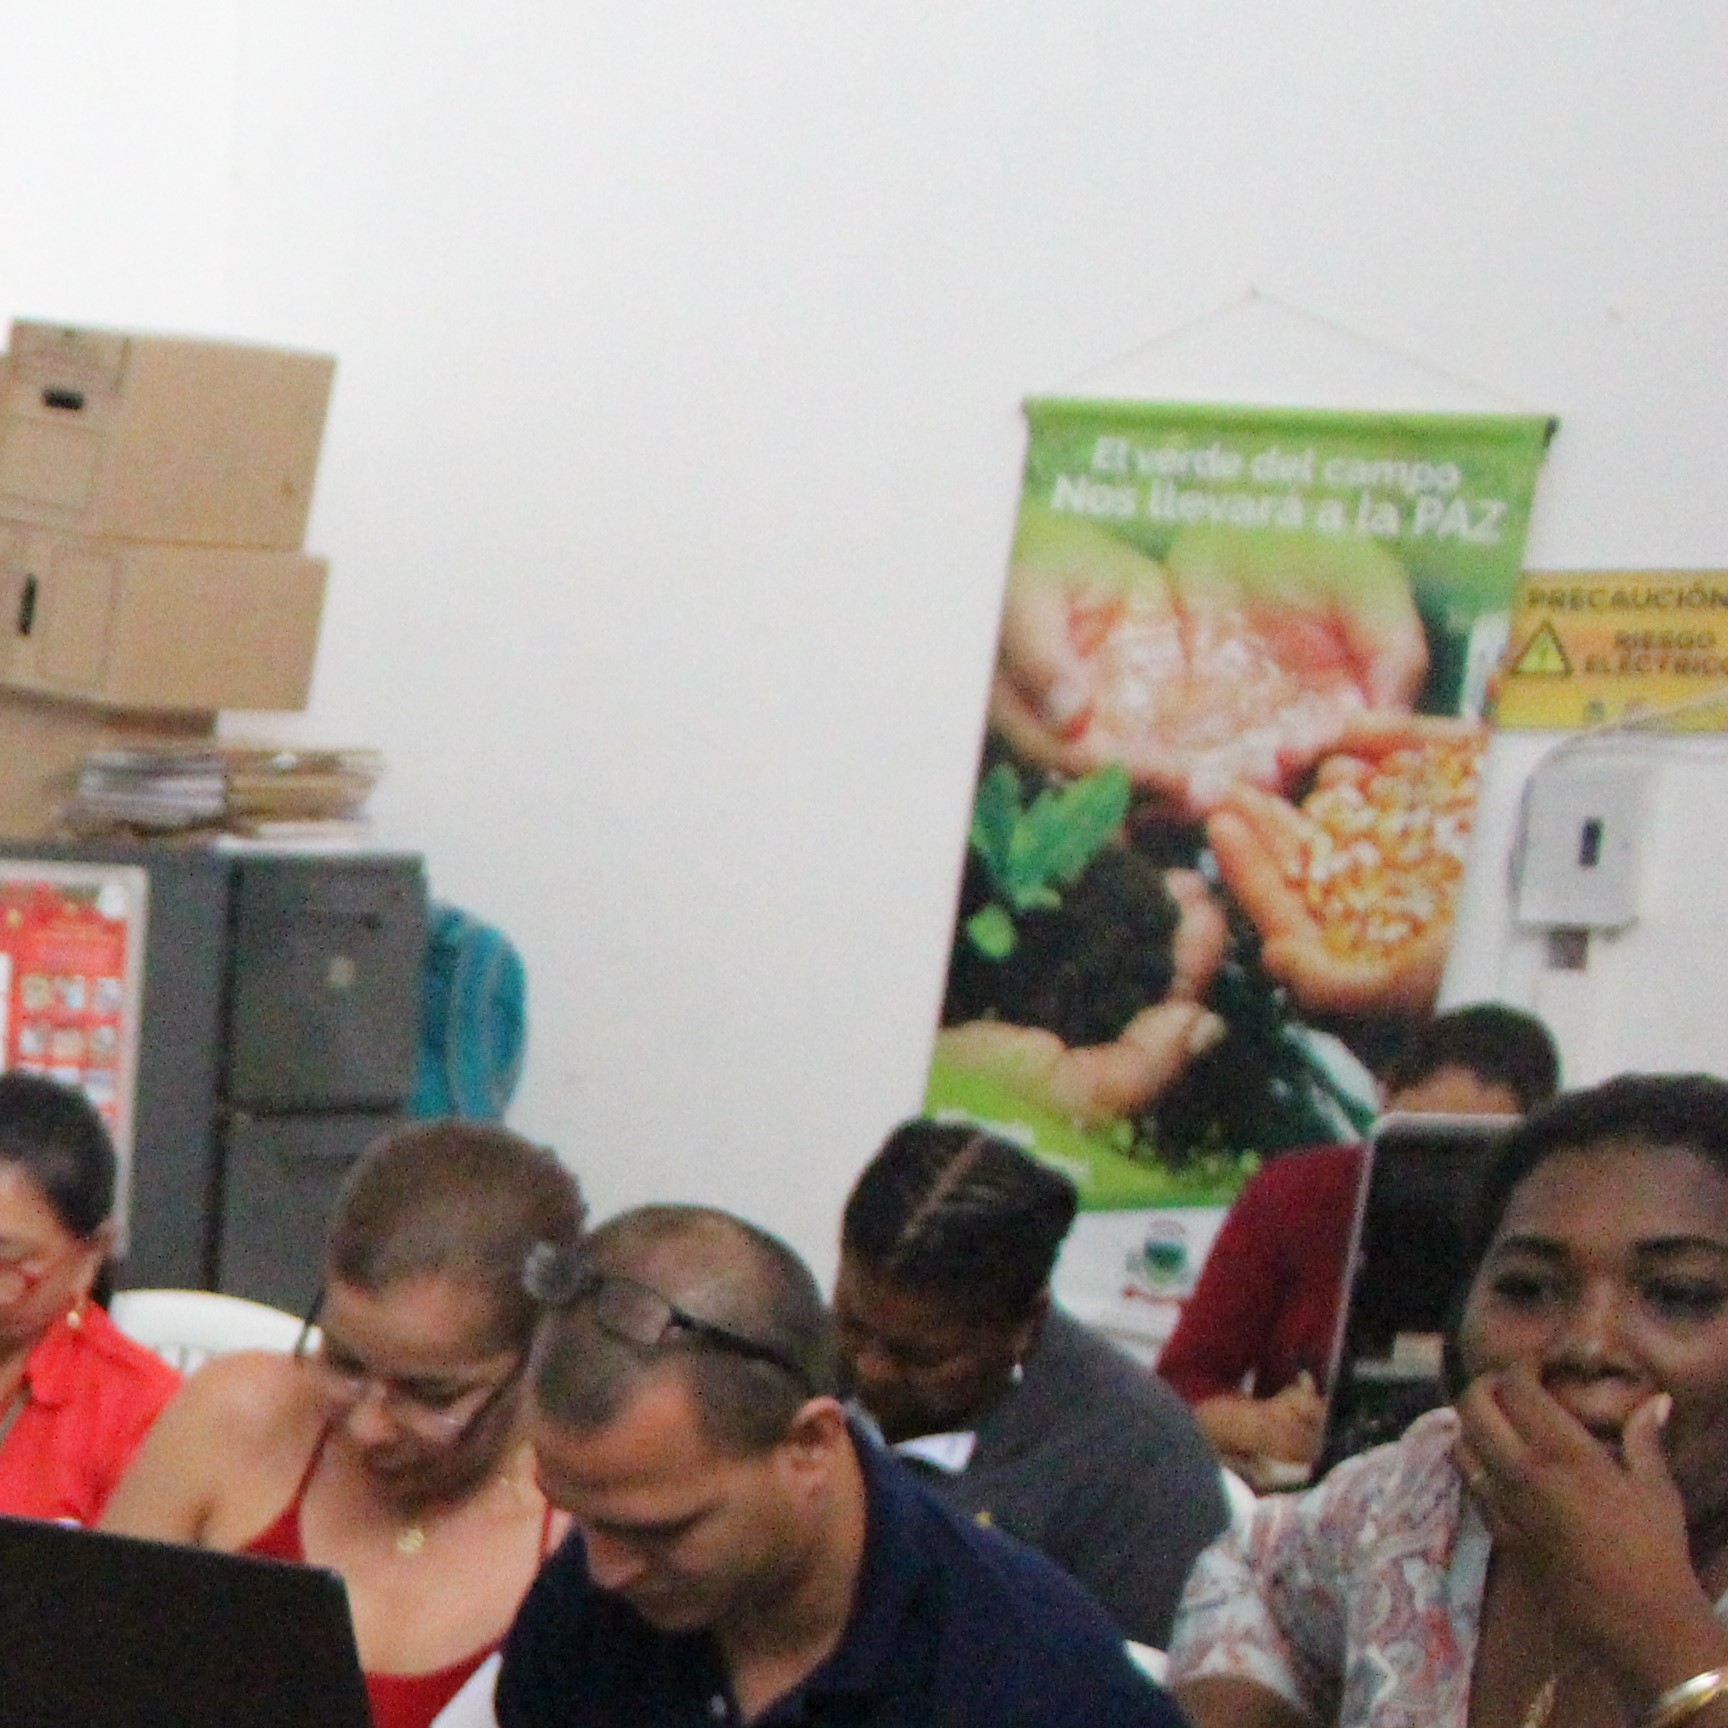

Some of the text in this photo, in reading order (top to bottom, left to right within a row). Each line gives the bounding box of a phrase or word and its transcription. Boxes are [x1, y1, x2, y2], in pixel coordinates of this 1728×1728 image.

[1092, 436, 1461, 496] El verde del campo
[1052, 474, 1137, 518] Nos
[1316, 500, 1345, 534] a
[1358, 491, 1401, 537] la
[1414, 496, 1507, 545] PAZ
